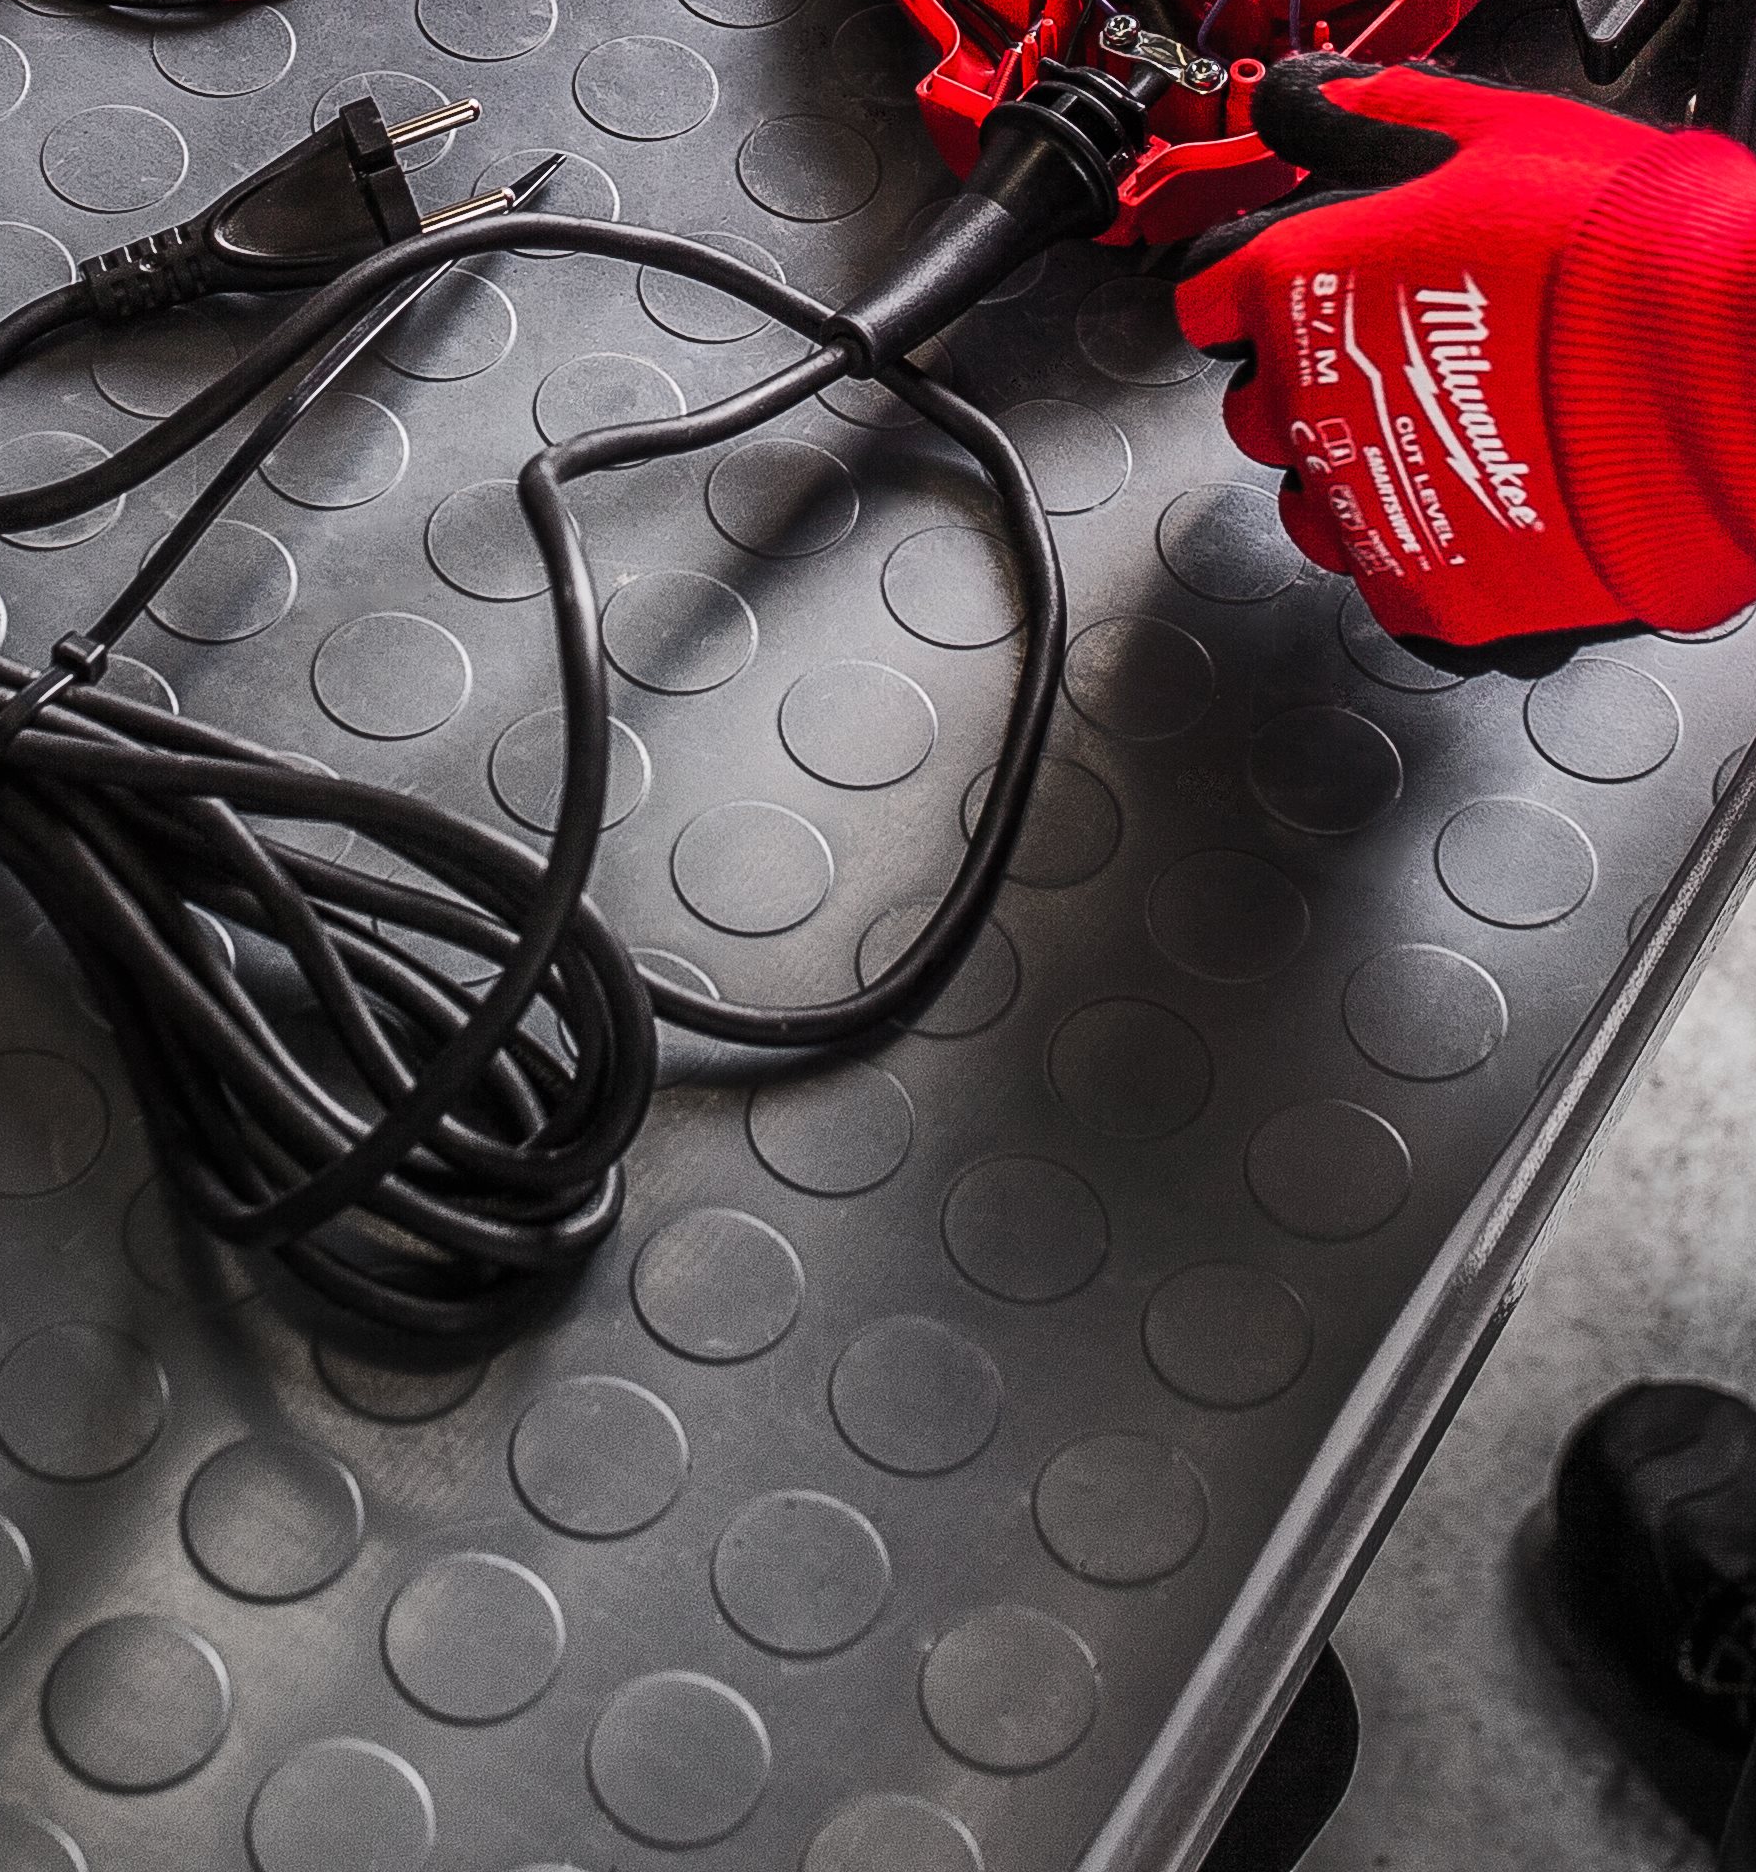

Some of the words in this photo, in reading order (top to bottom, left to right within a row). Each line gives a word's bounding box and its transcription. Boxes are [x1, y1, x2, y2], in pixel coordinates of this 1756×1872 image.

[1313, 348, 1340, 385] M
[1415, 270, 1539, 529] Milwaukee
[1362, 444, 1422, 554] SMARTSWIPE
[1395, 415, 1426, 467] CUT
[1413, 472, 1455, 548] LEVEL
[1448, 554, 1467, 566] 1
